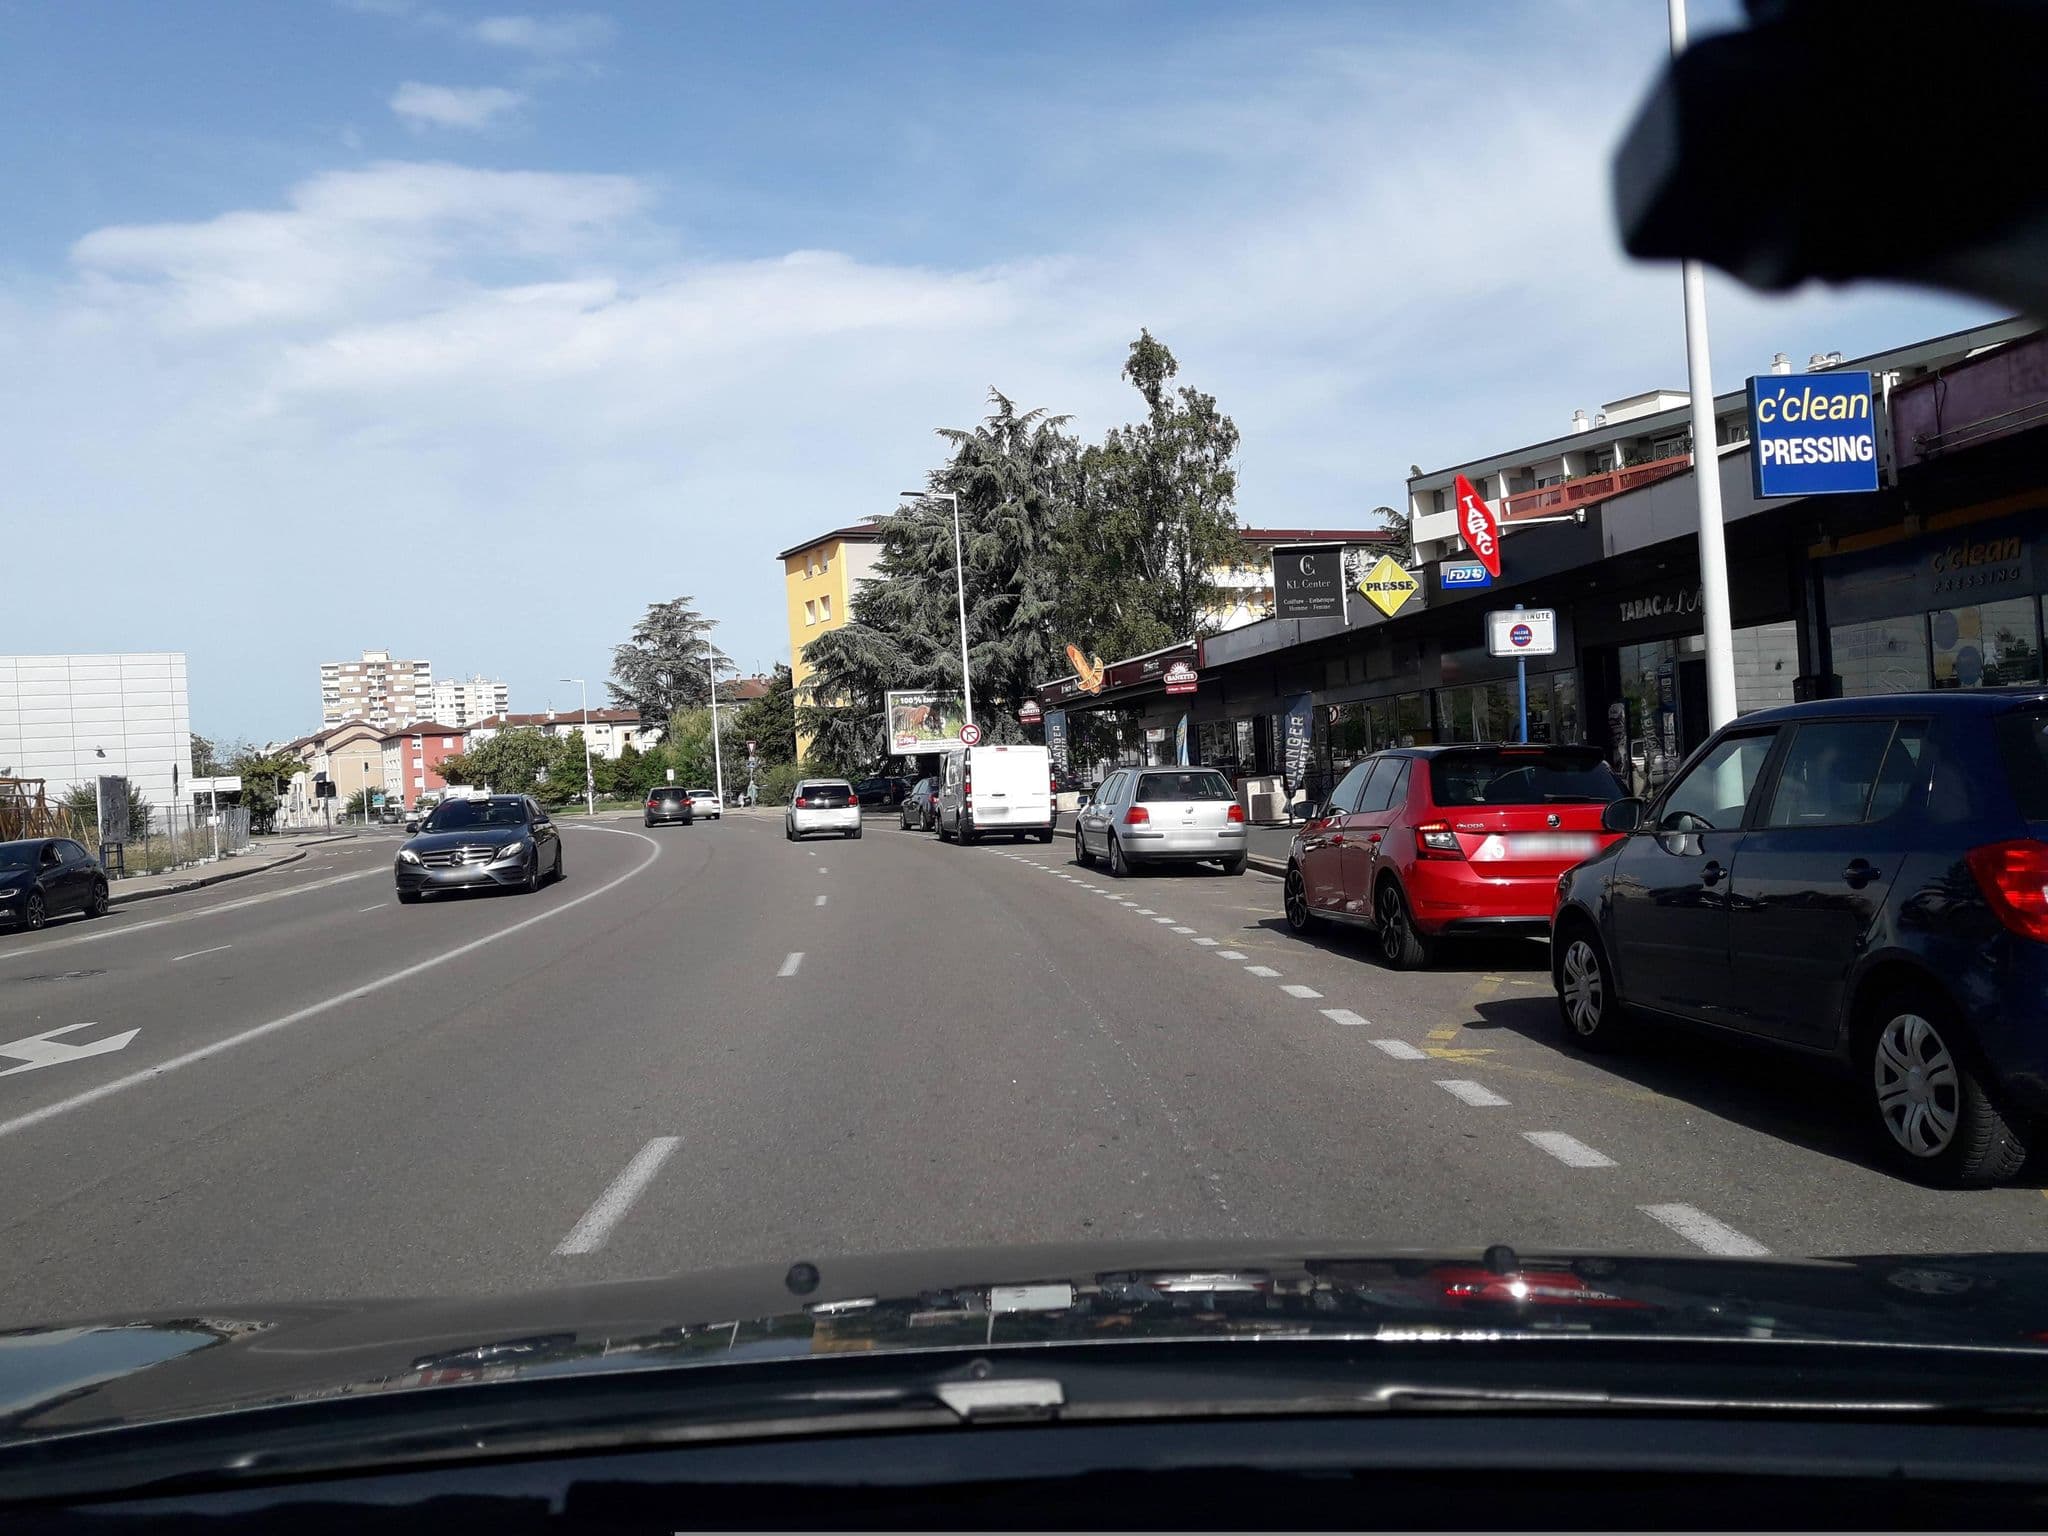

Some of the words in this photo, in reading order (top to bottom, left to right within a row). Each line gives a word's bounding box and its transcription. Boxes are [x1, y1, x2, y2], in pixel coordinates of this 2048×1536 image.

[1758, 386, 1869, 423] c'clean
[1760, 434, 1873, 466] PRESSING
[1462, 495, 1494, 556] TABAC
[1286, 580, 1300, 589] KL
[1301, 579, 1331, 588] Center
[1365, 581, 1415, 592] PRESSE
[1450, 569, 1471, 580] FDJ
[1934, 567, 2020, 593] PRESSING
[1620, 595, 1662, 622] TABAC
[1285, 716, 1304, 787] ULANGER
